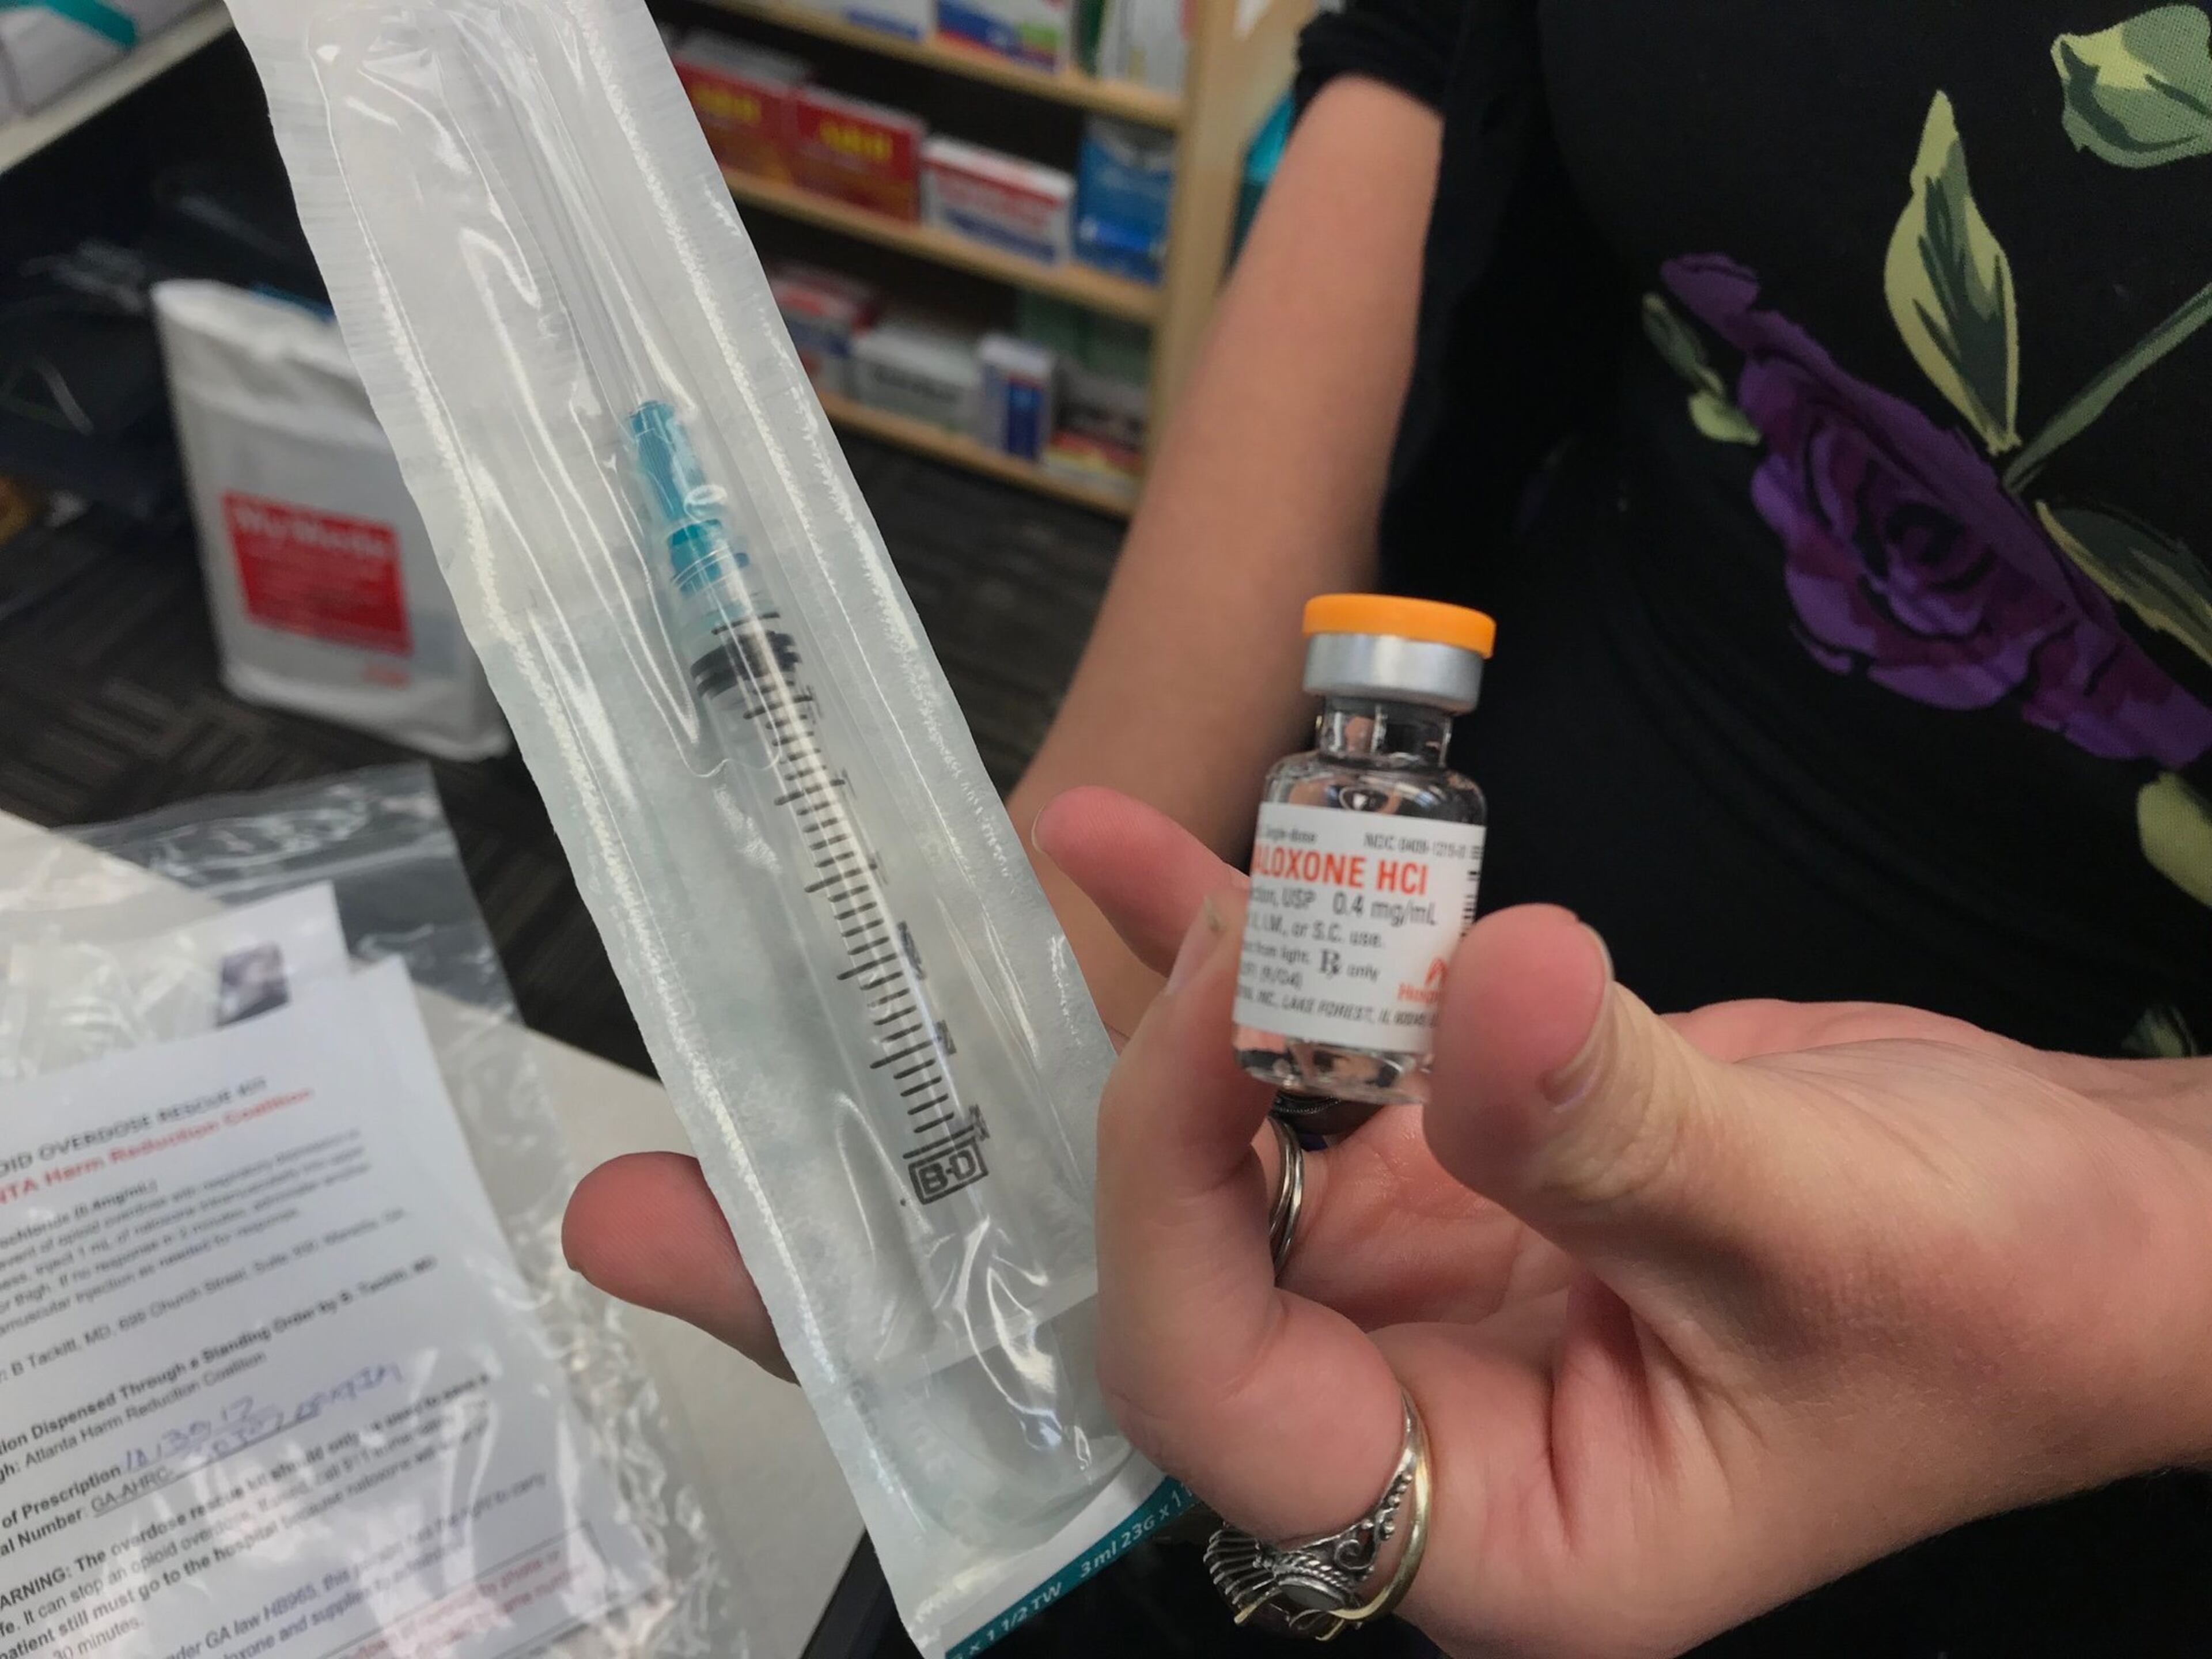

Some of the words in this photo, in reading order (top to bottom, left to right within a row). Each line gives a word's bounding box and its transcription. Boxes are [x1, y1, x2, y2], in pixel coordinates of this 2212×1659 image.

[1363, 832, 1394, 851] NDC
[1282, 886, 1316, 909] USP
[1332, 889, 1363, 917] 0.4
[1370, 899, 1437, 927] mg/mL
[1347, 963, 1381, 983] only
[1281, 994, 1314, 1013] LAKE
[38, 1113, 151, 1161] OVERDOSE
[44, 1156, 104, 1185] Harm
[109, 1121, 219, 1163] Reduction
[31, 1392, 117, 1442] Dispensed
[119, 1362, 187, 1400] Through
[25, 1436, 78, 1468] Atlanta
[79, 1416, 123, 1443] Harm
[125, 1382, 201, 1422] Reduction
[1, 1510, 18, 1529] of
[21, 1465, 122, 1520] Prescription
[74, 1550, 107, 1573] The
[109, 1513, 187, 1557] overdose
[1120, 1519, 1155, 1548] 23G
[37, 1595, 67, 1619] can
[69, 1577, 104, 1604] stop
[108, 1566, 128, 1585] an
[130, 1541, 179, 1574] opioid
[58, 1609, 90, 1637] still
[92, 1588, 137, 1622] must
[138, 1578, 161, 1603] go
[162, 1569, 182, 1586] to
[183, 1554, 212, 1577] the
[1033, 1581, 1063, 1611] TW
[77, 1616, 145, 1656] minutes.
[204, 1624, 232, 1649] GA
[233, 1613, 260, 1636] law
[278, 1613, 309, 1642] and
